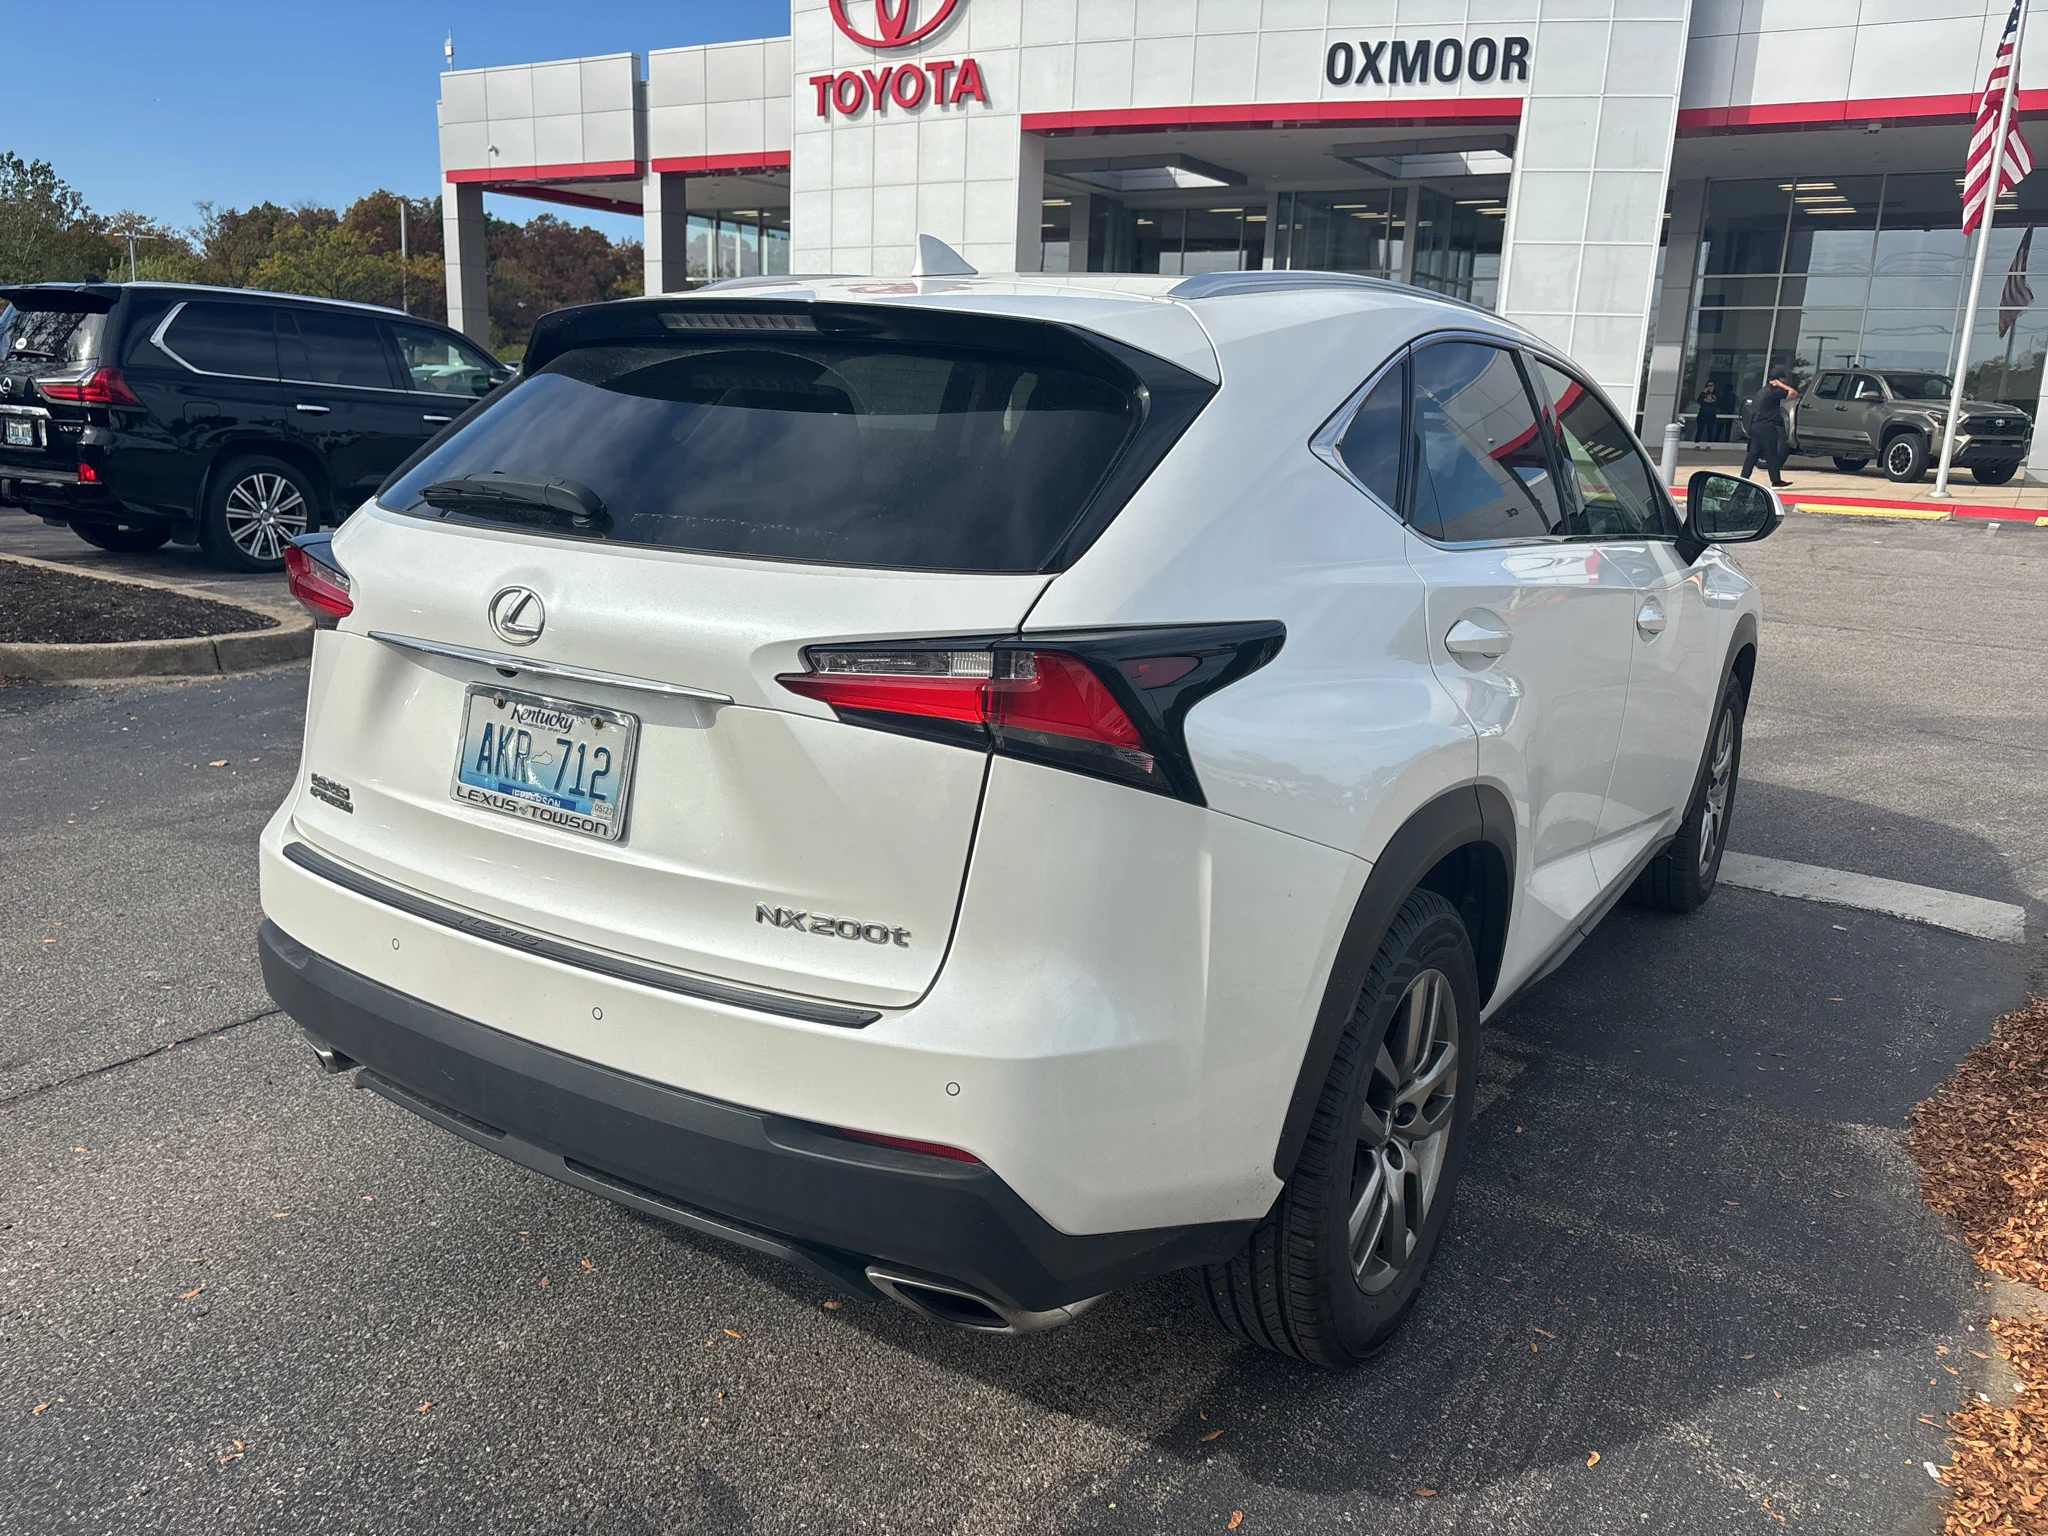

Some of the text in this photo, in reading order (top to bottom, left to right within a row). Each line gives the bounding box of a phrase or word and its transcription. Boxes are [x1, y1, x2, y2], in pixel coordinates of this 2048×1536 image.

[1326, 36, 1529, 85] OXMOOR
[809, 58, 986, 117] TOYOTA
[510, 703, 574, 735] Kentucky
[475, 722, 611, 800] AKR 712
[456, 785, 517, 812] LEXUS
[529, 805, 608, 836] TOWSON
[755, 901, 912, 949] NX200t
